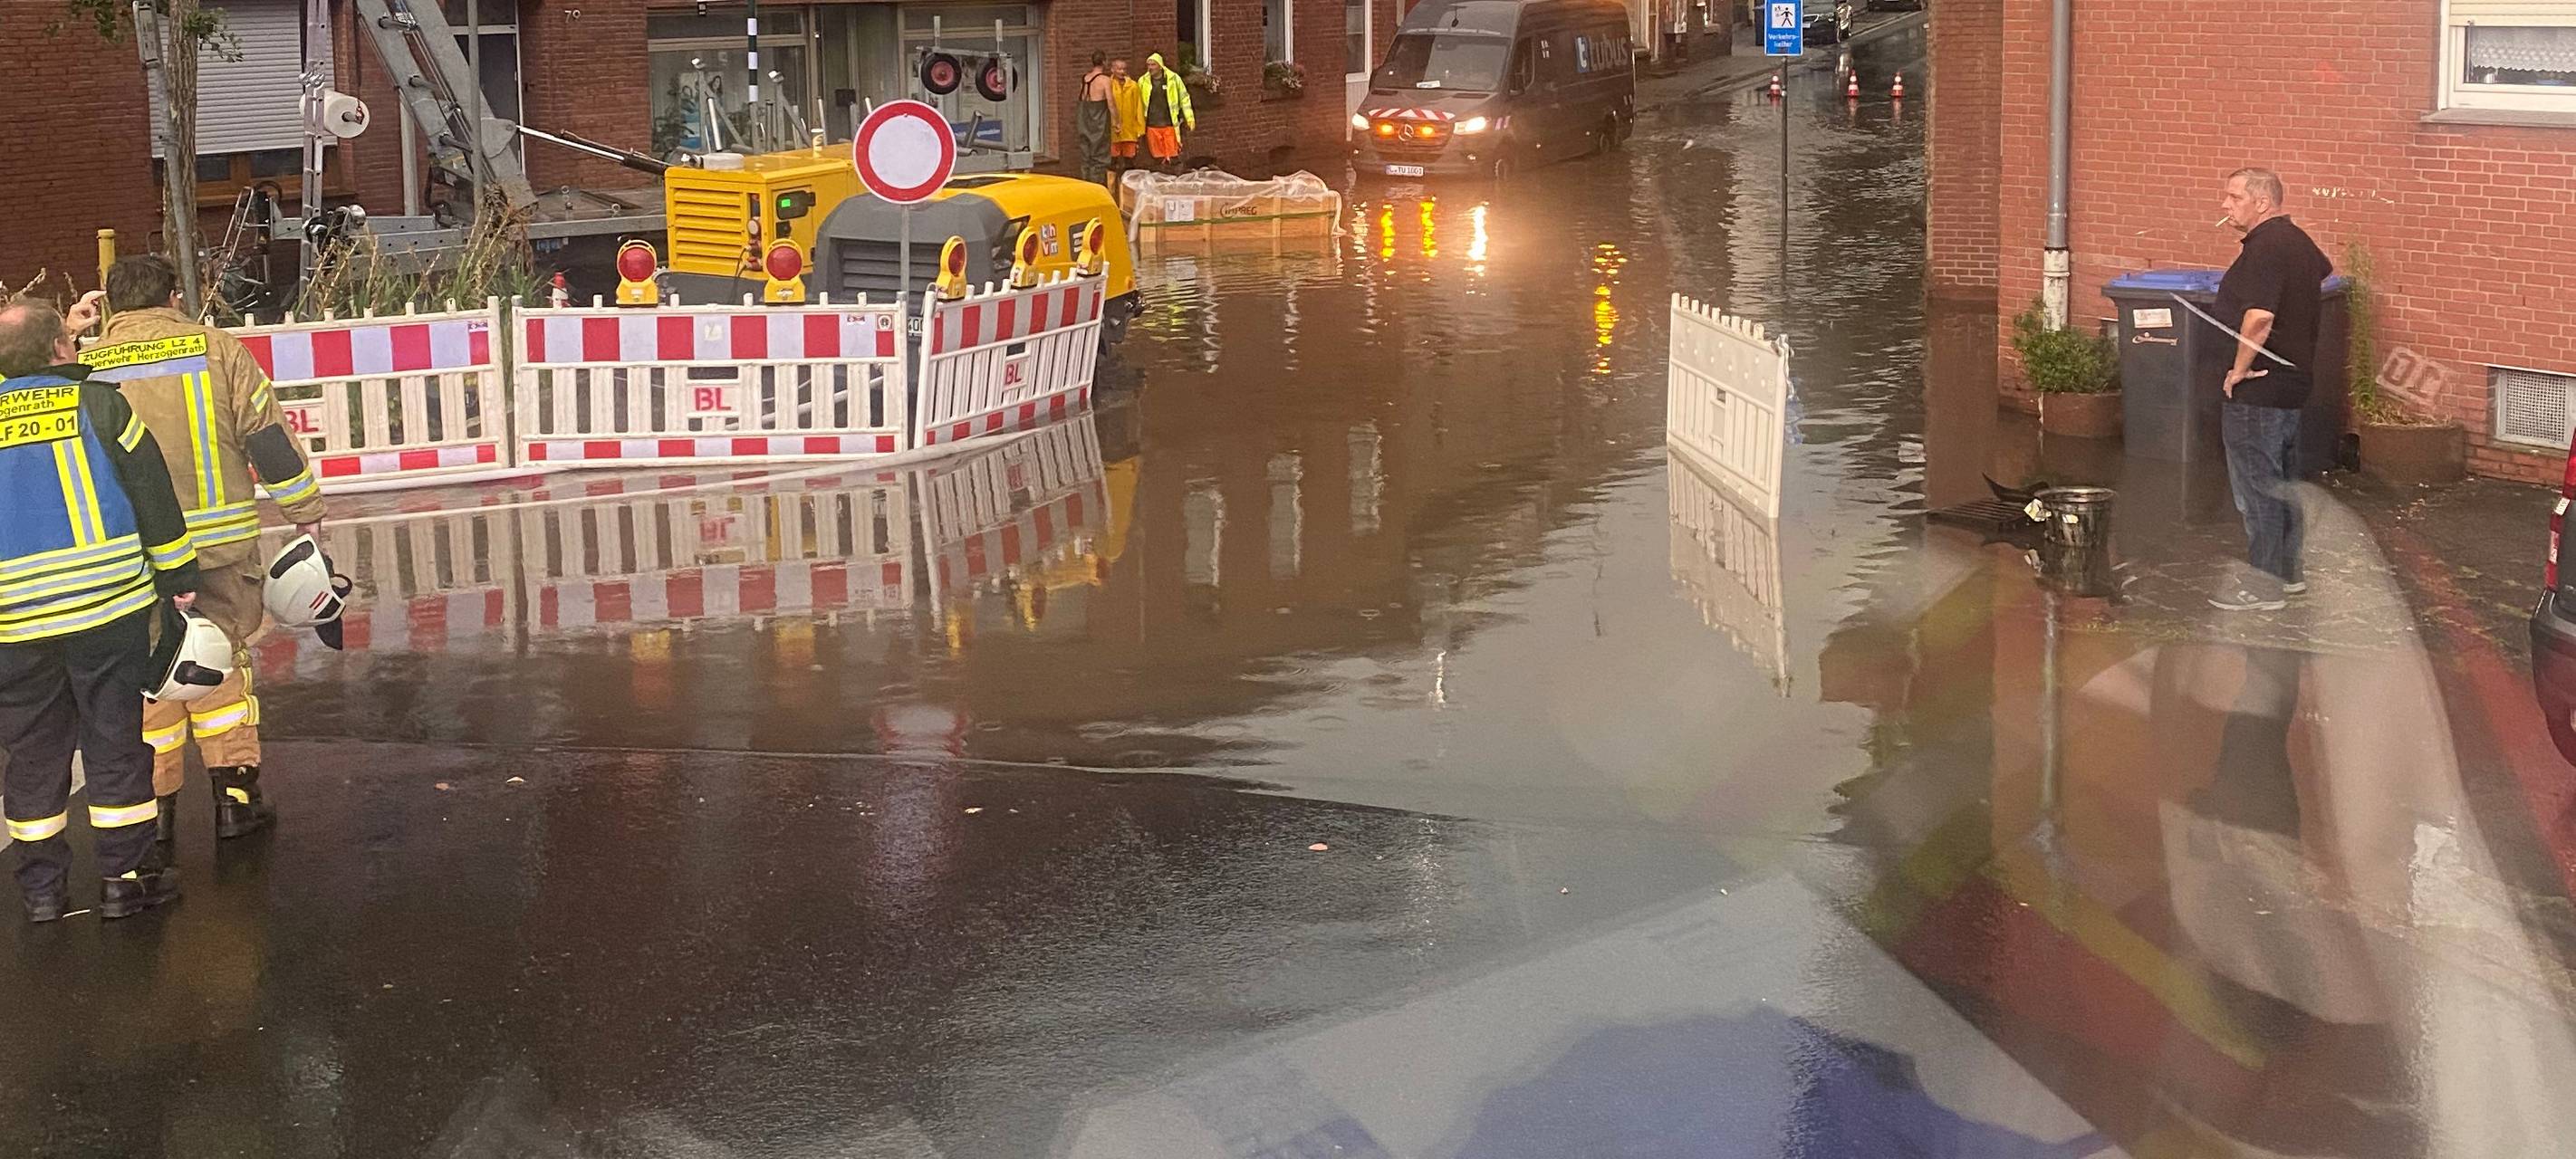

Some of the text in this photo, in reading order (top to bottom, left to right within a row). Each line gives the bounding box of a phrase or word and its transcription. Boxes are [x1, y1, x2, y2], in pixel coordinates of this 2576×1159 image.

[192, 337, 201, 345] 4
[137, 344, 205, 361] Herzogenrath
[1004, 362, 1022, 386] BL
[695, 387, 732, 411] BL
[18, 421, 41, 437] 20
[55, 415, 75, 432] 01
